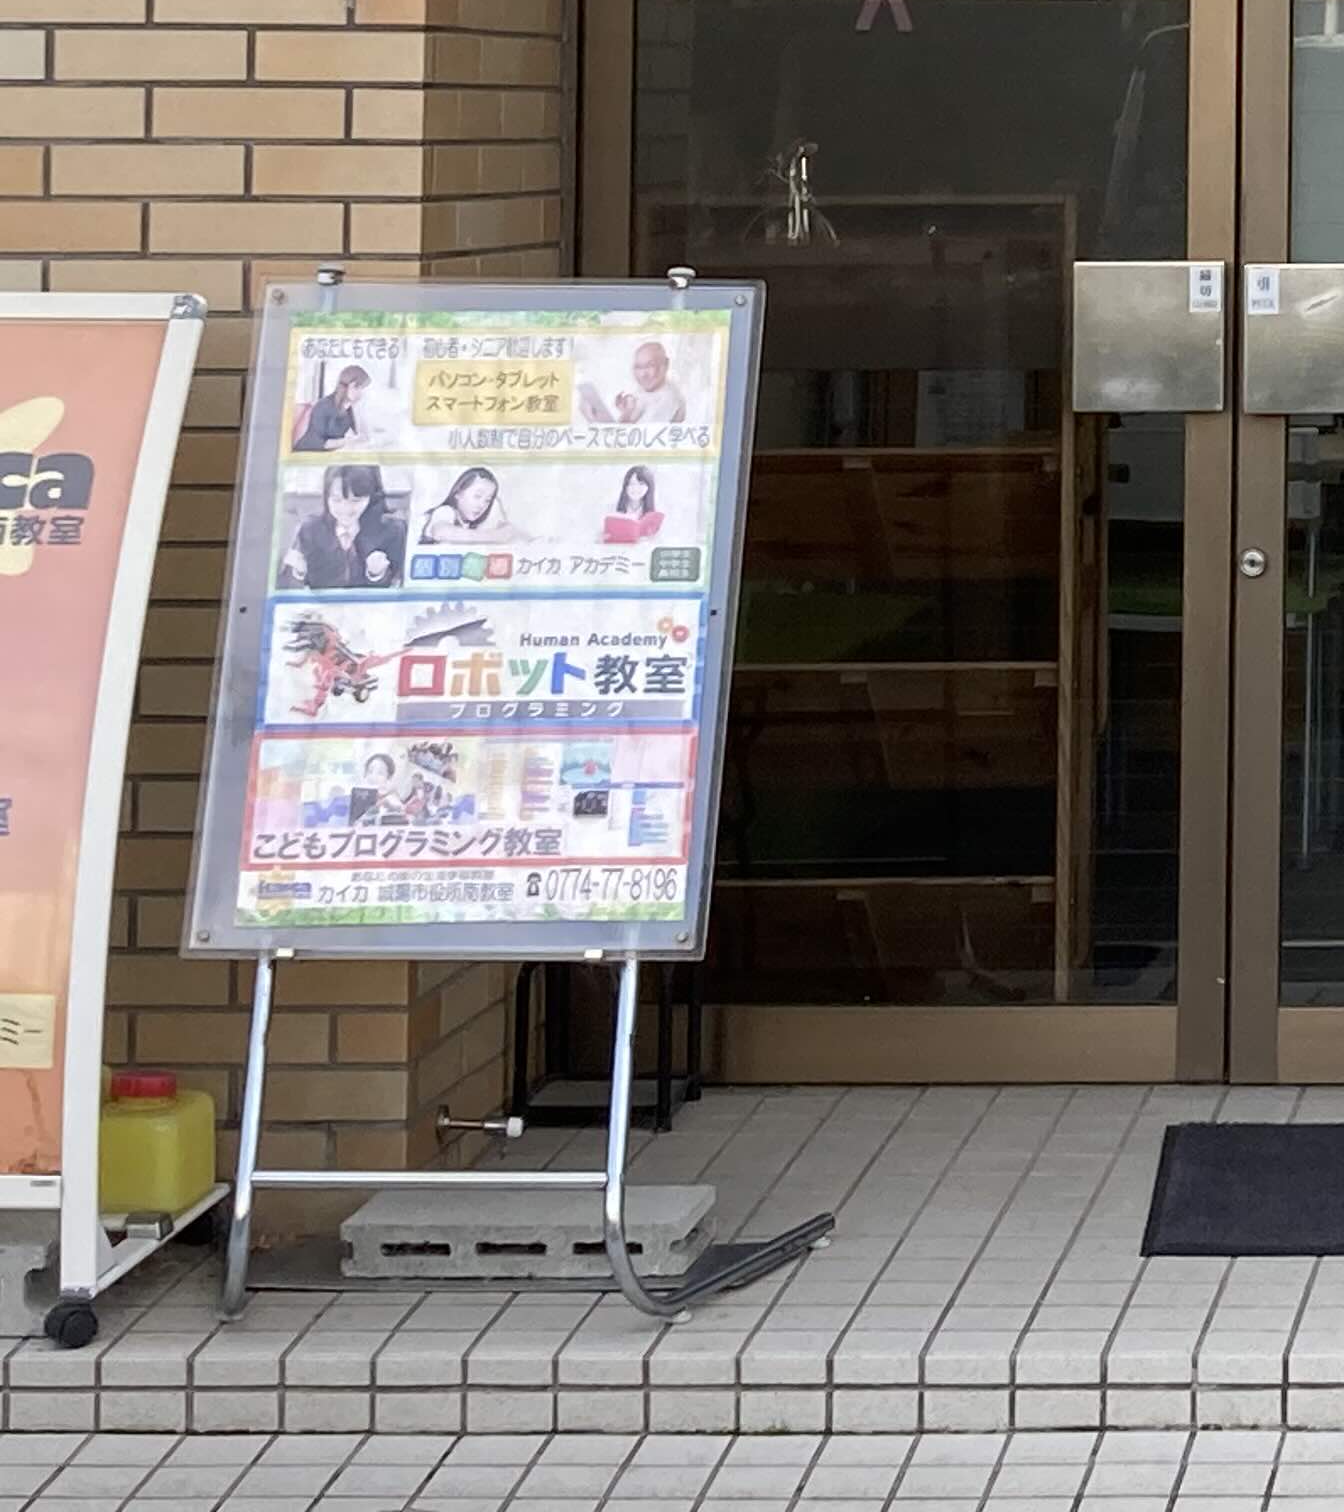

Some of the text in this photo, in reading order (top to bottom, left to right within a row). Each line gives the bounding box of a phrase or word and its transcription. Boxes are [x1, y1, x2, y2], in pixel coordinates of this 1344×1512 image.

[425, 394, 561, 413] スマートフォン教室
[0, 514, 85, 546] 教室
[516, 557, 561, 575] カイカ
[520, 632, 668, 651] Human Academy
[397, 651, 687, 699] ロボット教室
[449, 701, 625, 720] プログラミング
[253, 827, 563, 861] こどもプログラミング教室
[546, 867, 678, 901] 0774-77-8196
